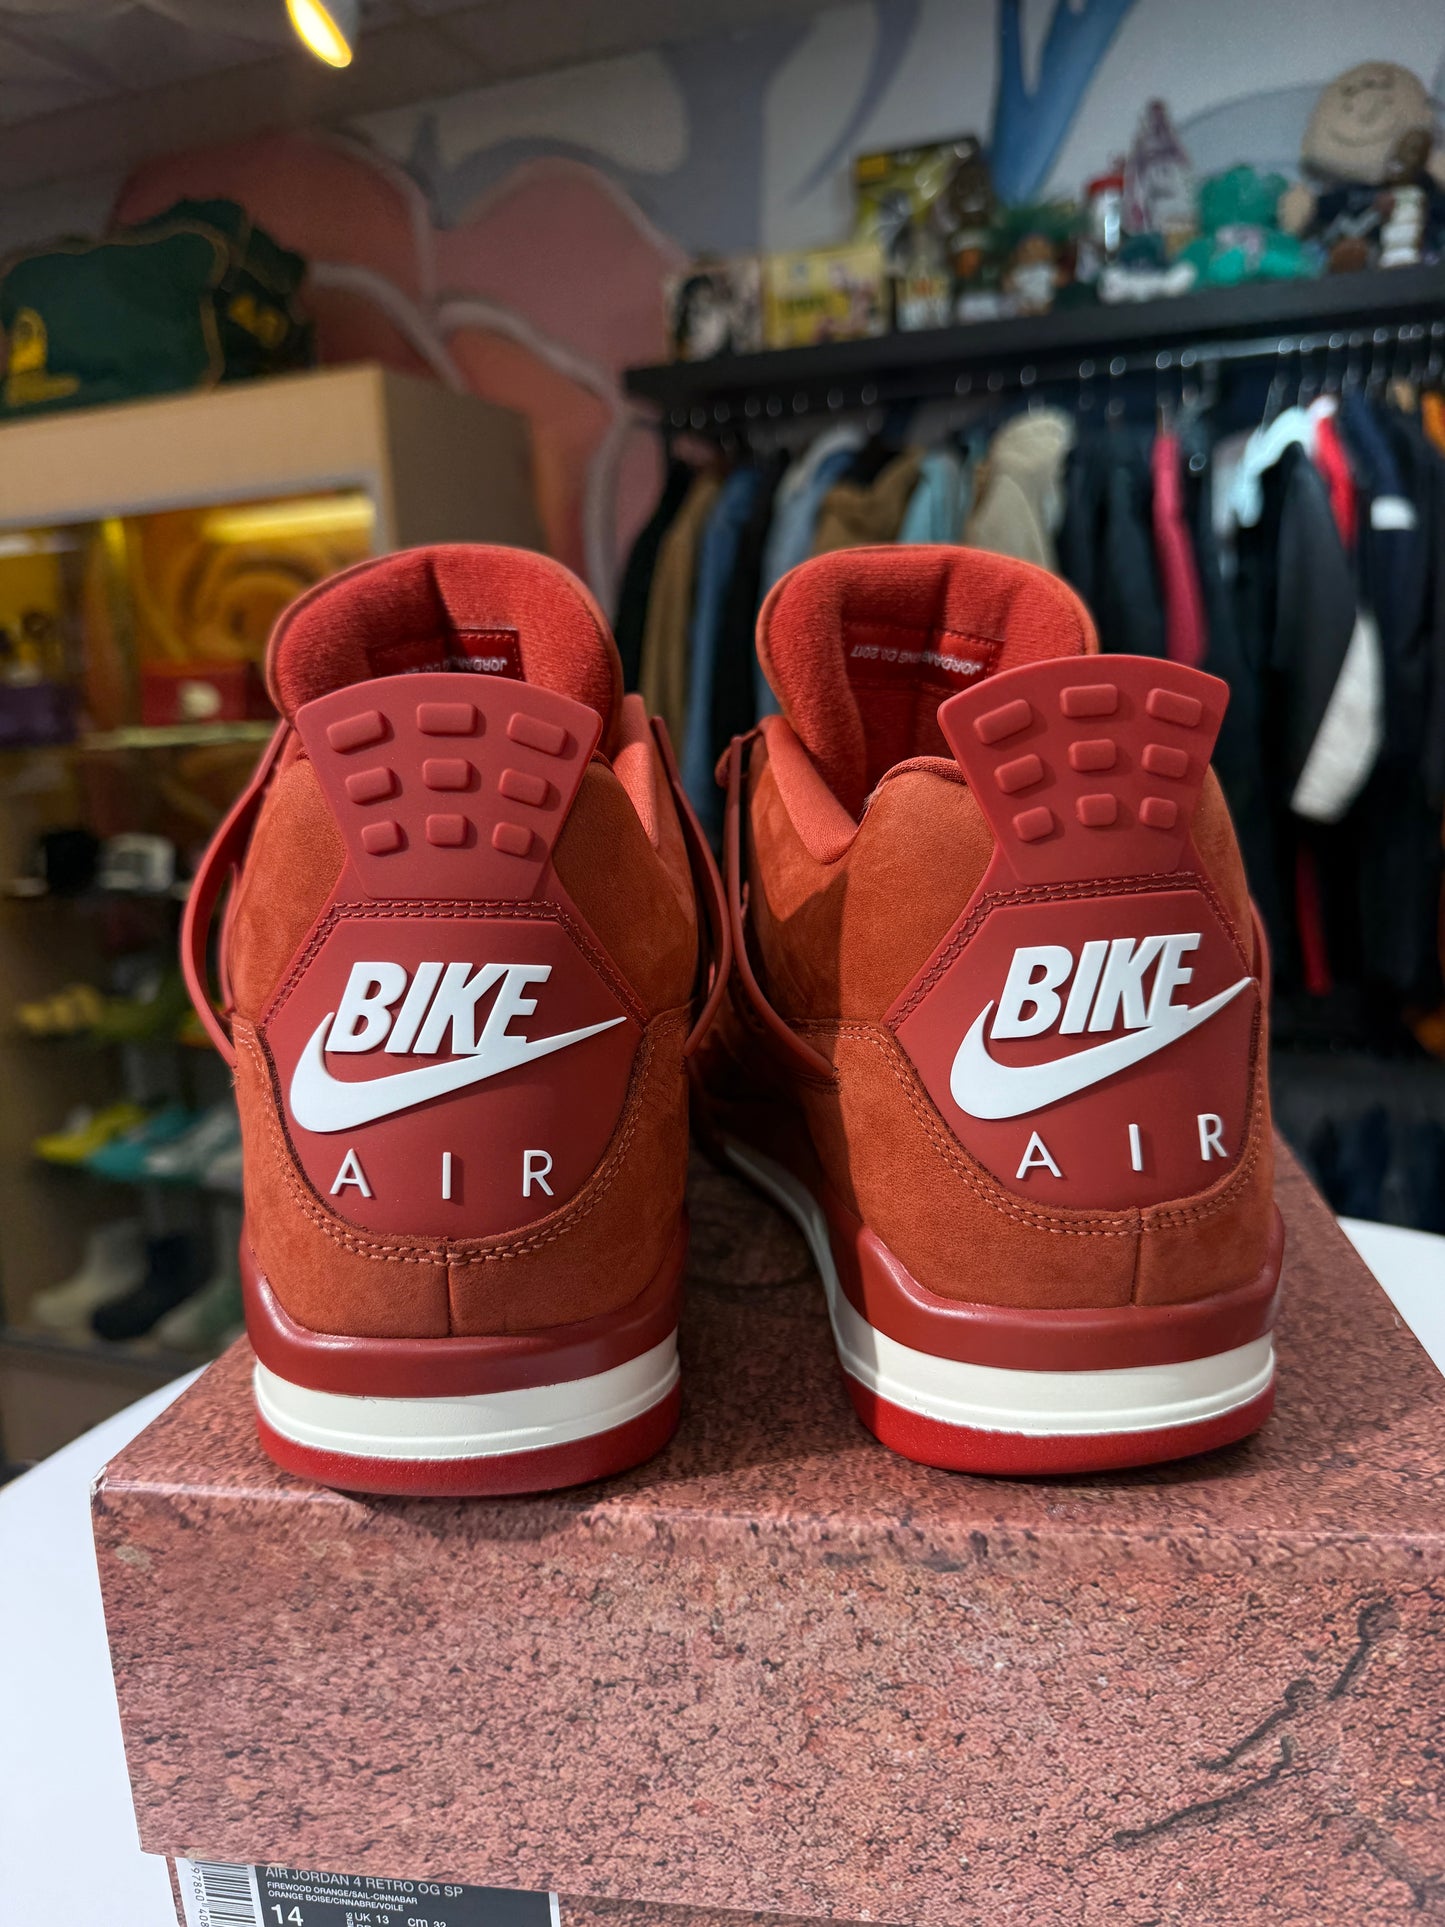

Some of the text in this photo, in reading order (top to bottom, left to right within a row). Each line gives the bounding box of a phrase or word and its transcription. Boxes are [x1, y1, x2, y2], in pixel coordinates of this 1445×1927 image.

[987, 932, 1202, 1040] BIKE
[324, 961, 553, 1055] BIKE
[1015, 1113, 1228, 1179] AIR
[328, 1148, 554, 1200] AIR
[265, 1866, 464, 1898] AIR JORDAN 4 RETRO OG SP
[267, 1881, 418, 1905] FIREWOOD ORANGE/SAIL-CINNABAR
[268, 1890, 404, 1912] ORANGE BOISE/CINNABRE/VOILE
[271, 1903, 304, 1927] 14
[354, 1912, 390, 1925] UK 13
[407, 1917, 428, 1927] cm
